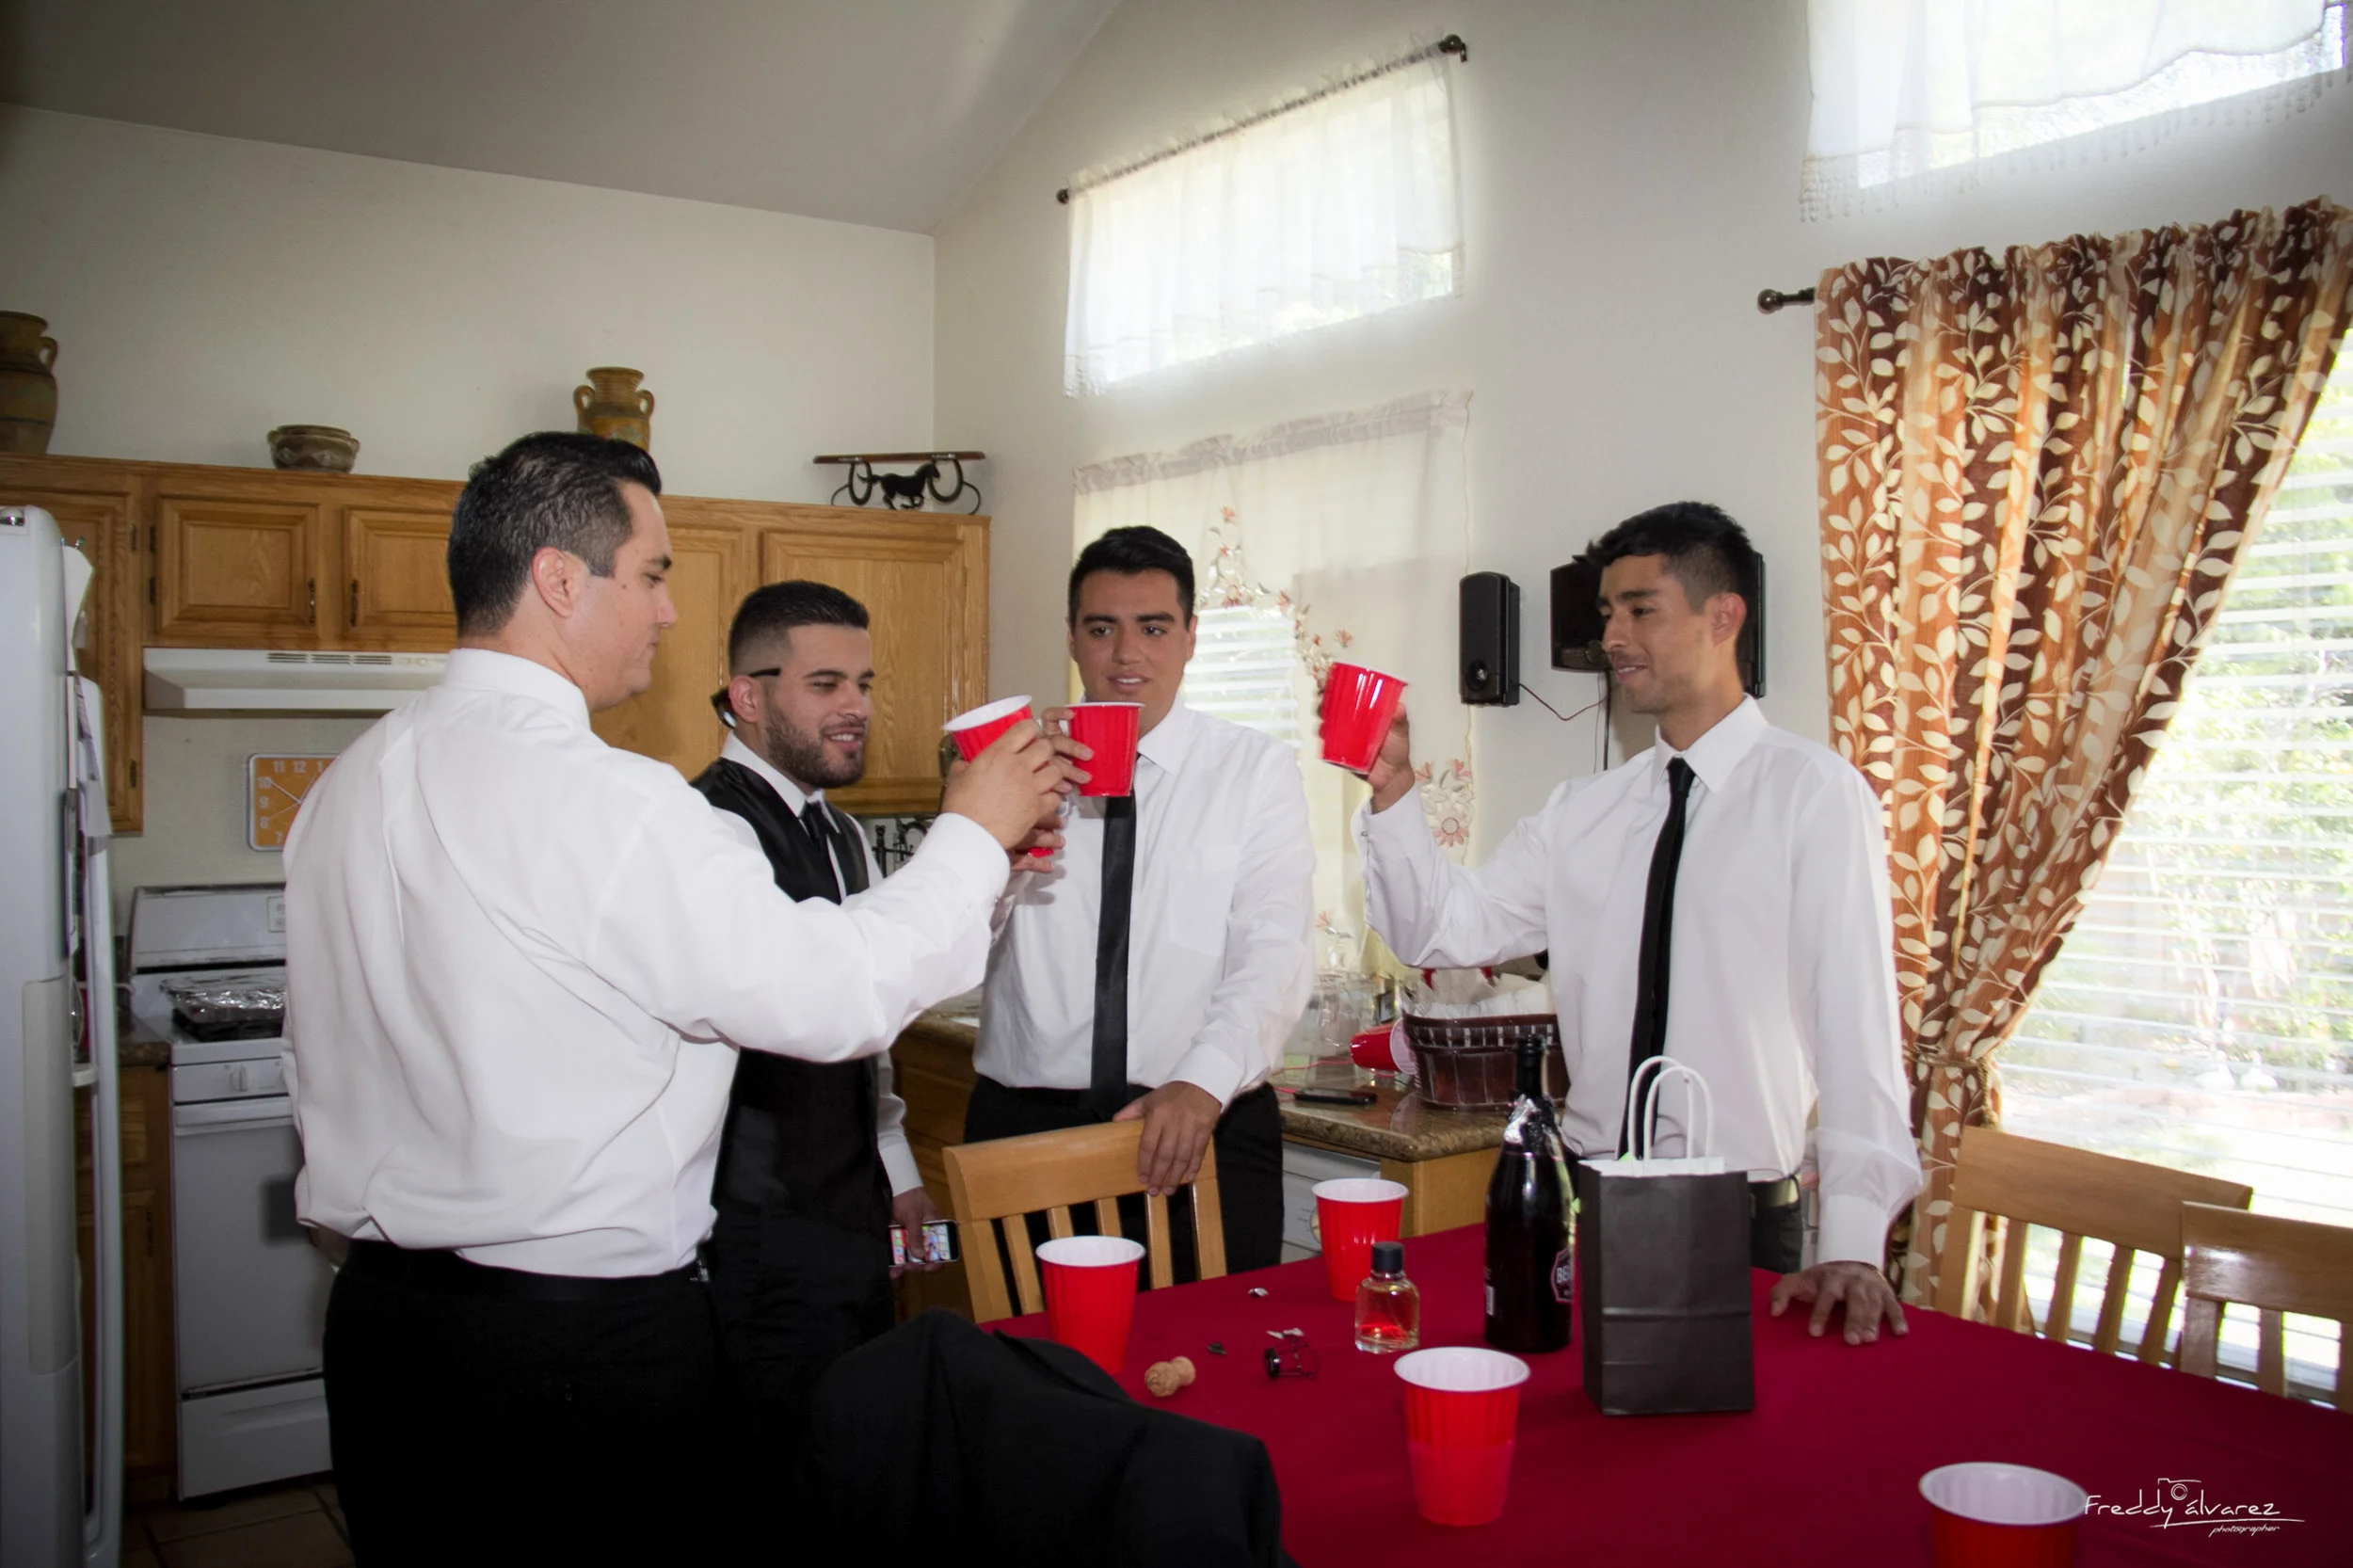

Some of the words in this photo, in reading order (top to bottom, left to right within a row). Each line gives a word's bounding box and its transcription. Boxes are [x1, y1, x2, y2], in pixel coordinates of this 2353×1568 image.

[272, 760, 285, 774] 11
[292, 760, 307, 774] 12
[259, 795, 269, 809] 9
